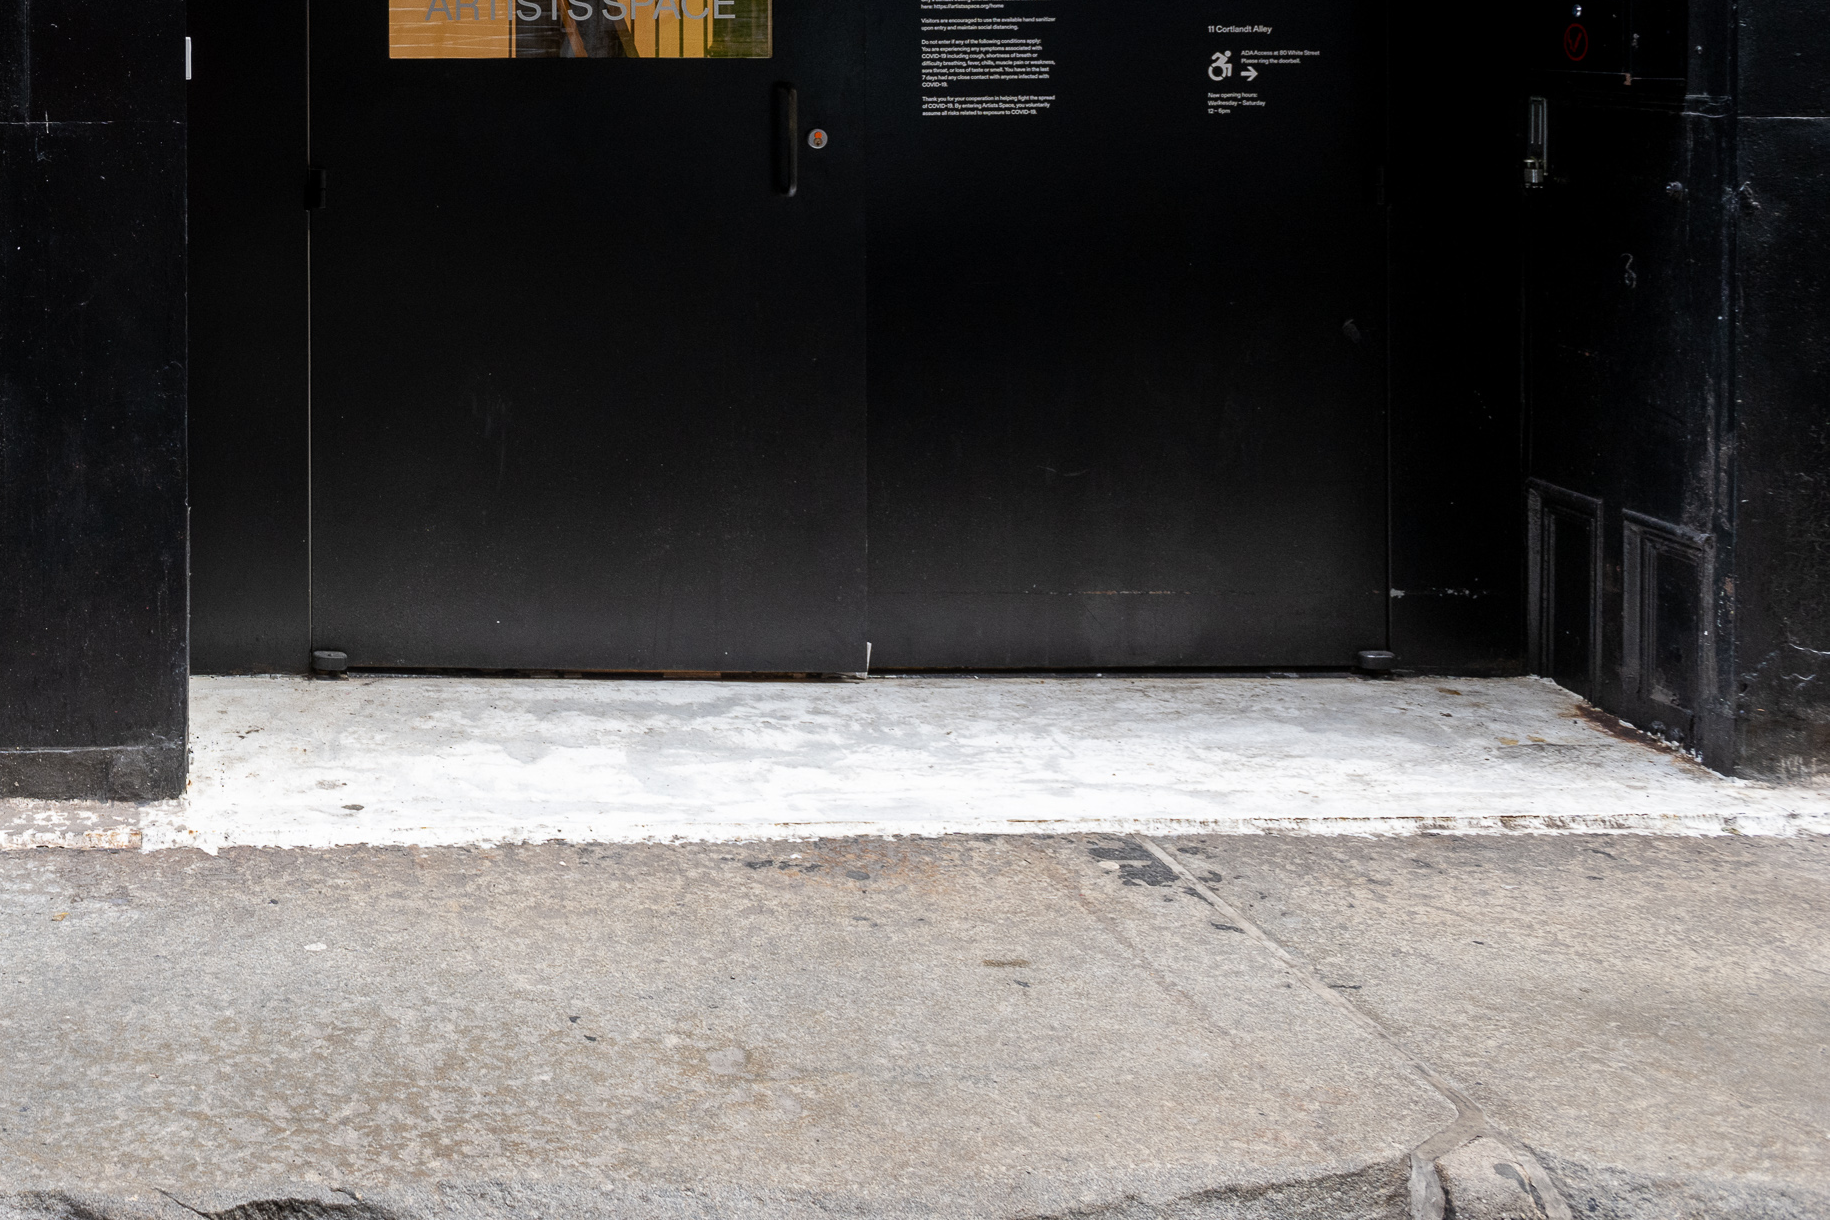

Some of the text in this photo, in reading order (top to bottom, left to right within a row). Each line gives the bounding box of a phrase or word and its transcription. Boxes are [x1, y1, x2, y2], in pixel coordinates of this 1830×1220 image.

[1208, 25, 1273, 35] 11 Cortlandt Alley
